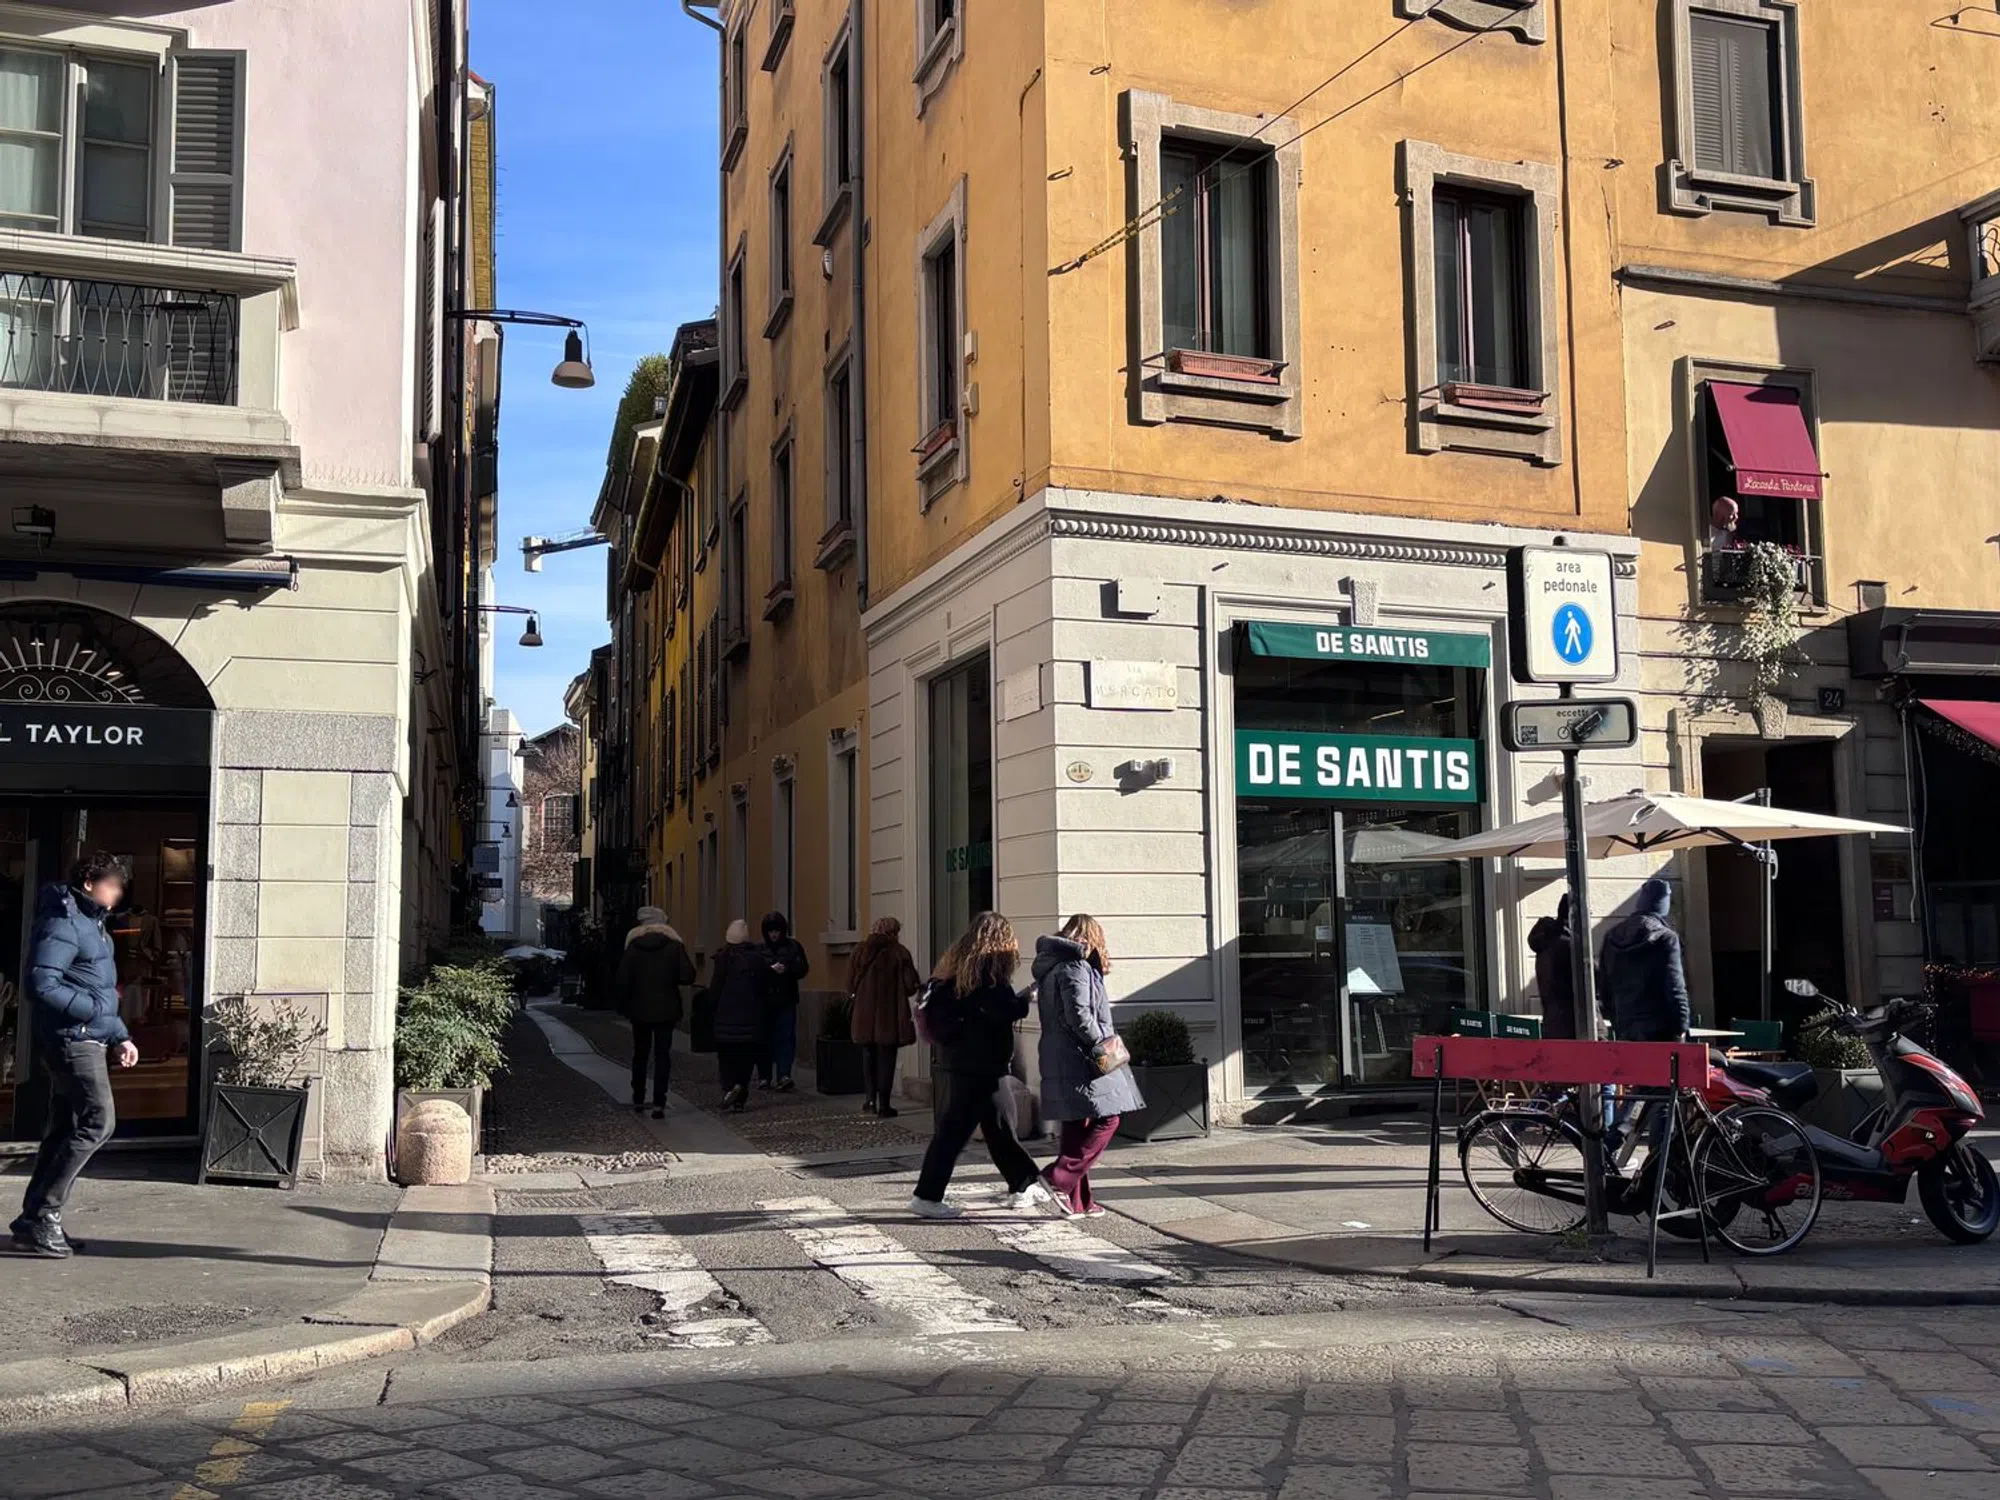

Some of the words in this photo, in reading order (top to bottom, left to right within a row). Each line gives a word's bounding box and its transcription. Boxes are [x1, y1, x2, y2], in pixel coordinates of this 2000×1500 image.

[1556, 562, 1582, 573] area
[1543, 578, 1598, 594] pedonale
[1315, 631, 1344, 654] DE
[1349, 633, 1429, 658] SANTIS
[1824, 690, 1841, 707] 24
[25, 723, 144, 746] TAYLOR
[1248, 742, 1302, 786] DE
[1316, 745, 1470, 791] SANTIS
